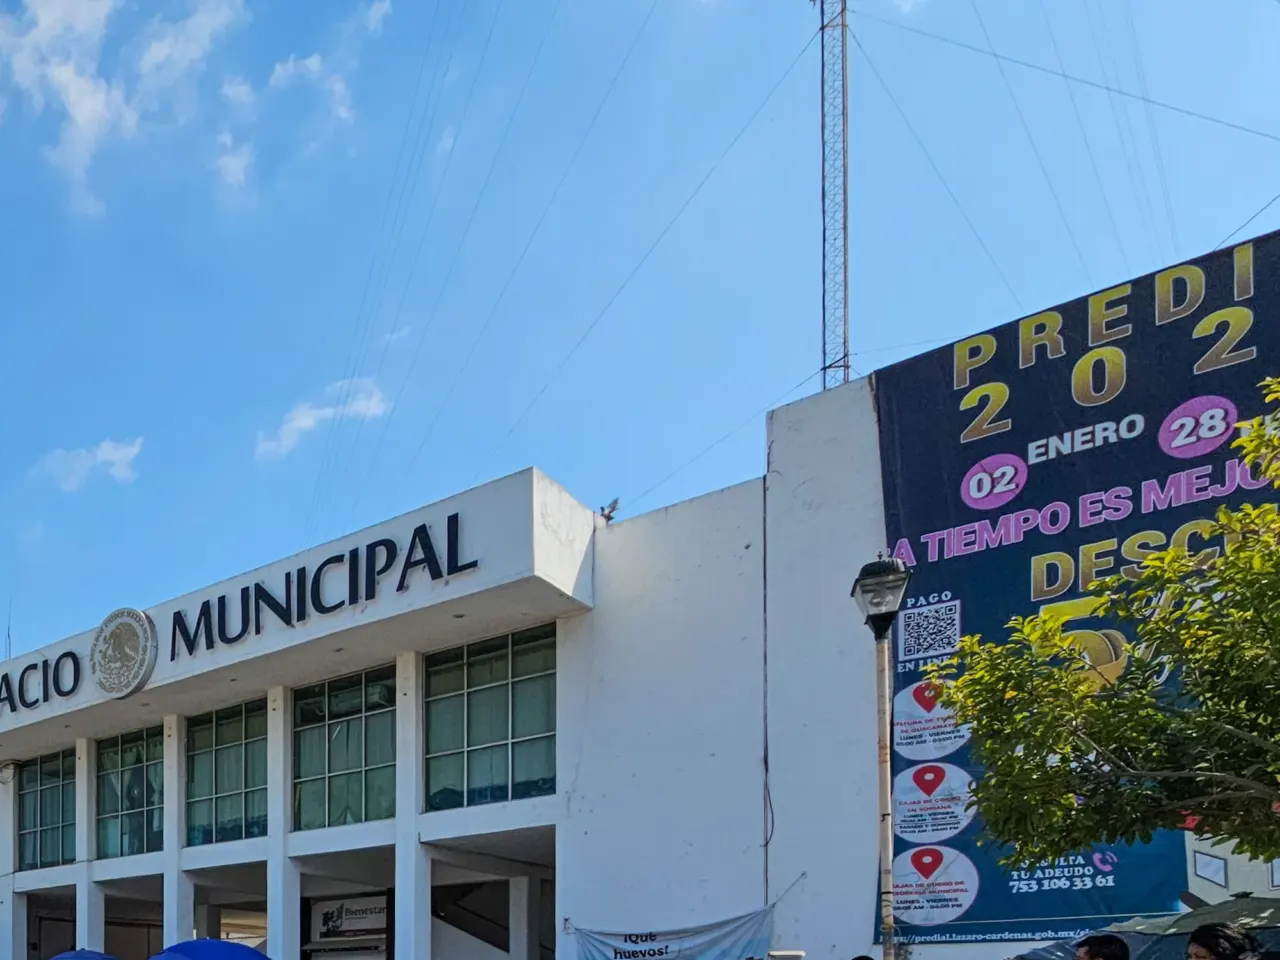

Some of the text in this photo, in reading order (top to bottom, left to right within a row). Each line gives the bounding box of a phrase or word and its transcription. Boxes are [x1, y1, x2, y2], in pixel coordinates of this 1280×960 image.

[969, 465, 1017, 499] 02
[1027, 414, 1145, 465] ENERO
[1170, 408, 1227, 448] 28
[921, 501, 1071, 562] TIEMPO
[1079, 486, 1132, 527] ES
[1141, 459, 1274, 514] MEJO
[170, 513, 479, 662] MUNICIPAL
[906, 590, 952, 608] PAGO
[897, 661, 915, 673] EN
[900, 733, 923, 741] LUNES
[929, 728, 960, 737] VIERNES
[1011, 866, 1094, 880] TU ADEUDO
[1009, 875, 1116, 894] 753 106 33 61
[344, 906, 387, 917] Bienestar
[613, 945, 669, 960] huevos!
